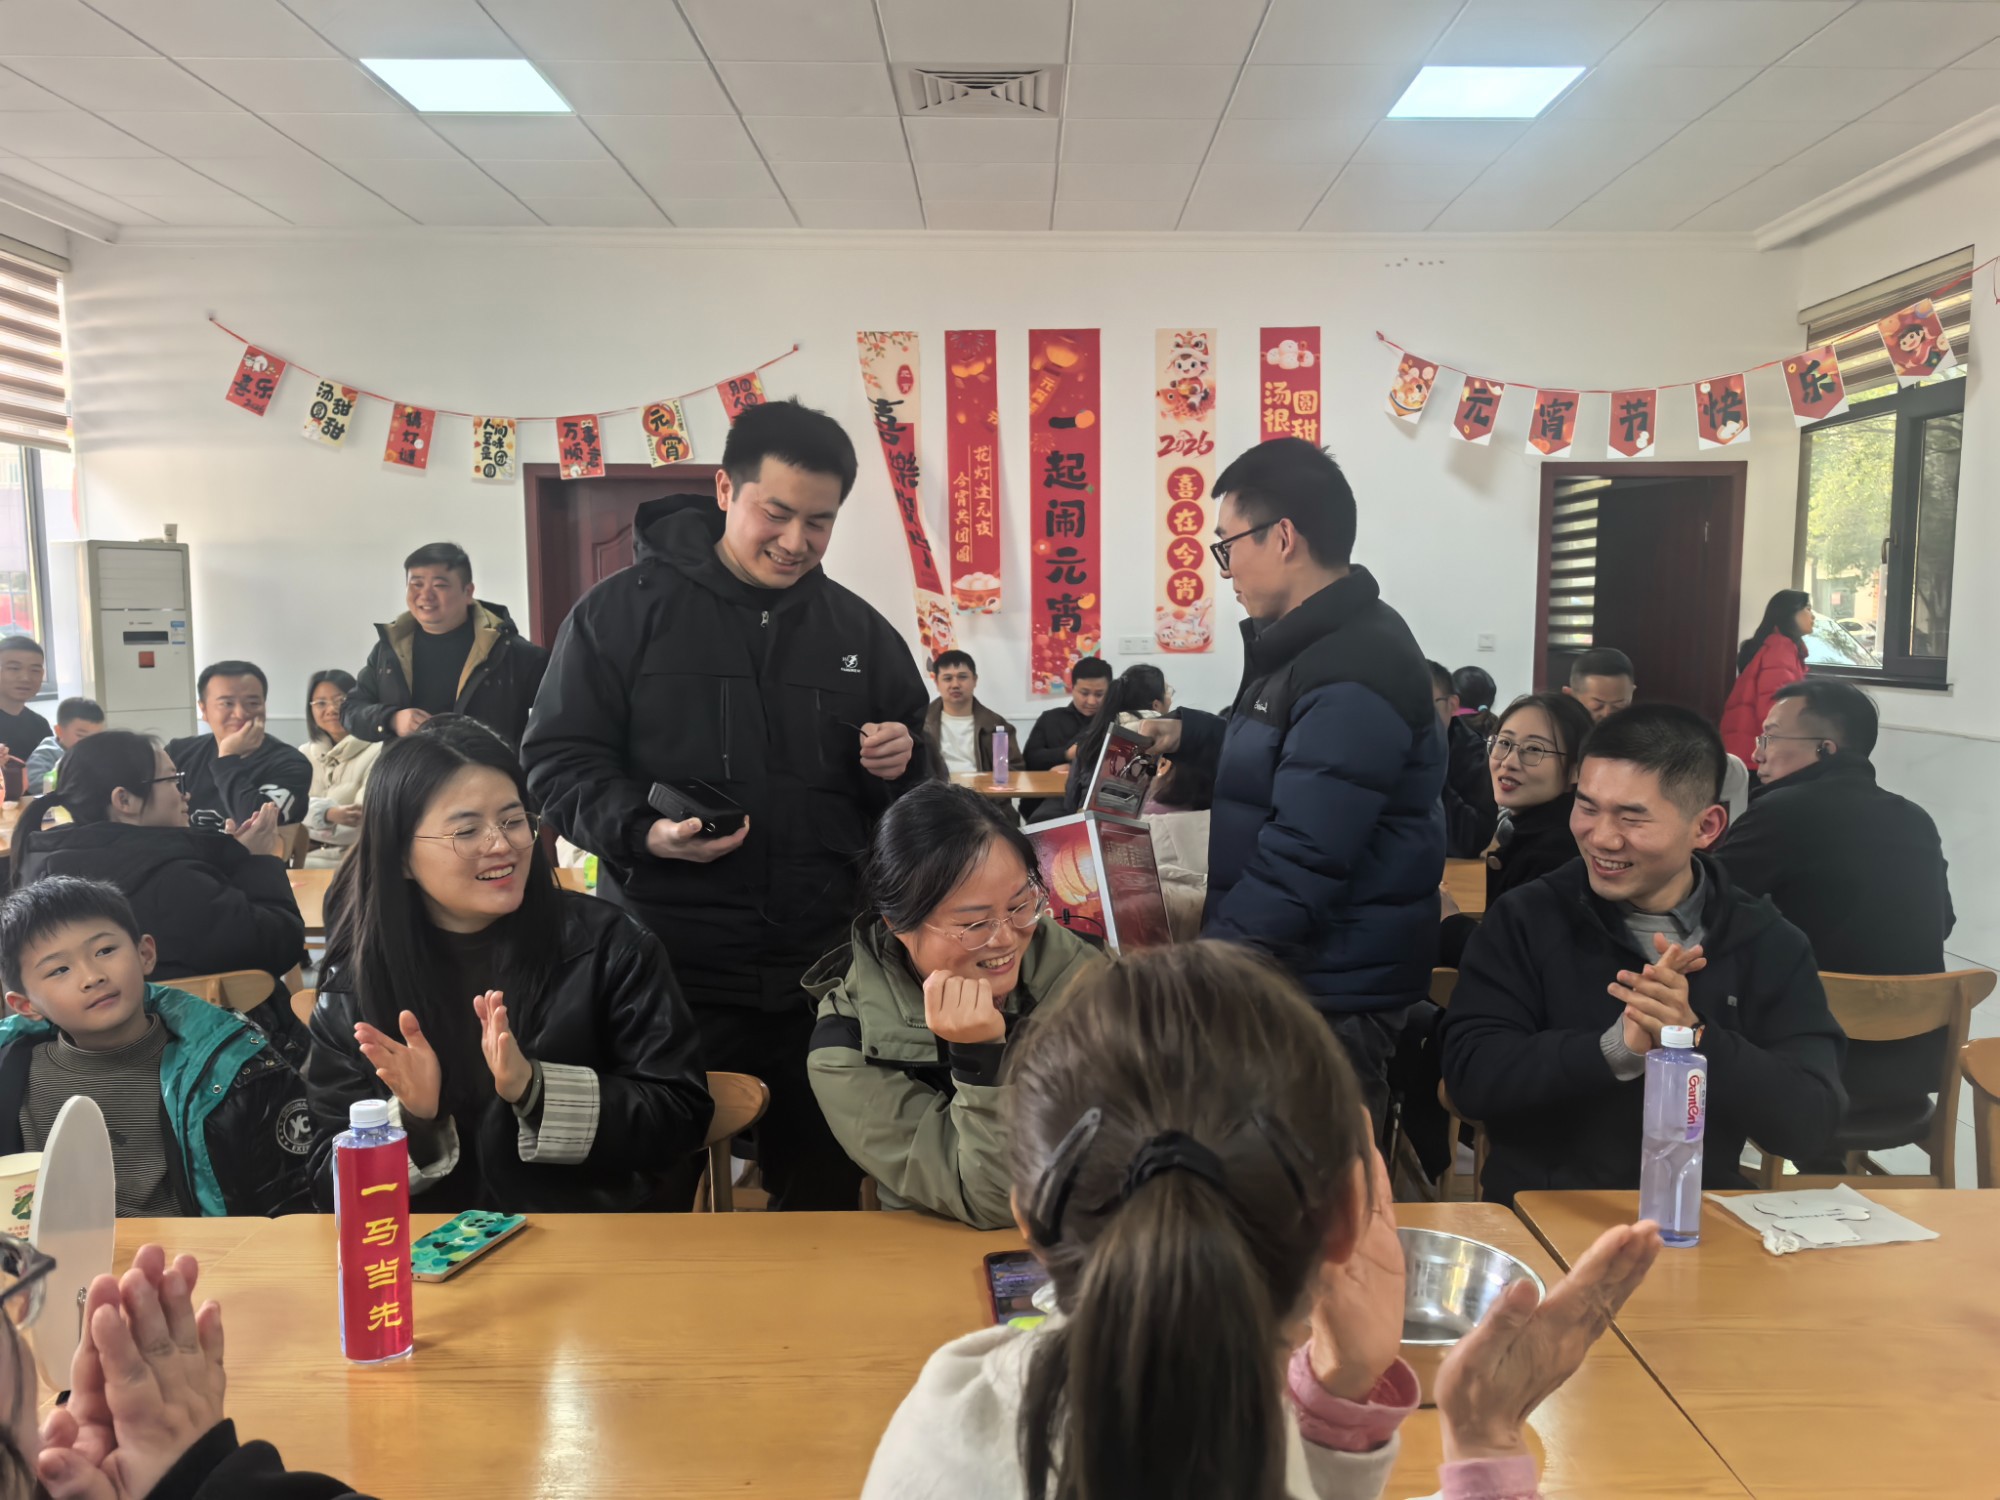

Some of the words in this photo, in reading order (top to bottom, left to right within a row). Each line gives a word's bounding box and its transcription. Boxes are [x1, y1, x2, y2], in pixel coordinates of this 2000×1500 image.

[650, 408, 682, 461] 元宵
[1157, 430, 1214, 458] 2026
[1463, 388, 1494, 428] 元
[1539, 398, 1574, 441] 宵
[1619, 398, 1649, 442] 节
[1703, 387, 1742, 430] 快
[1799, 359, 1836, 404] 乐
[1043, 416, 1089, 633] 一起闹元宵
[1173, 474, 1198, 600] 喜在今宵
[360, 1182, 403, 1331] 一马当先
